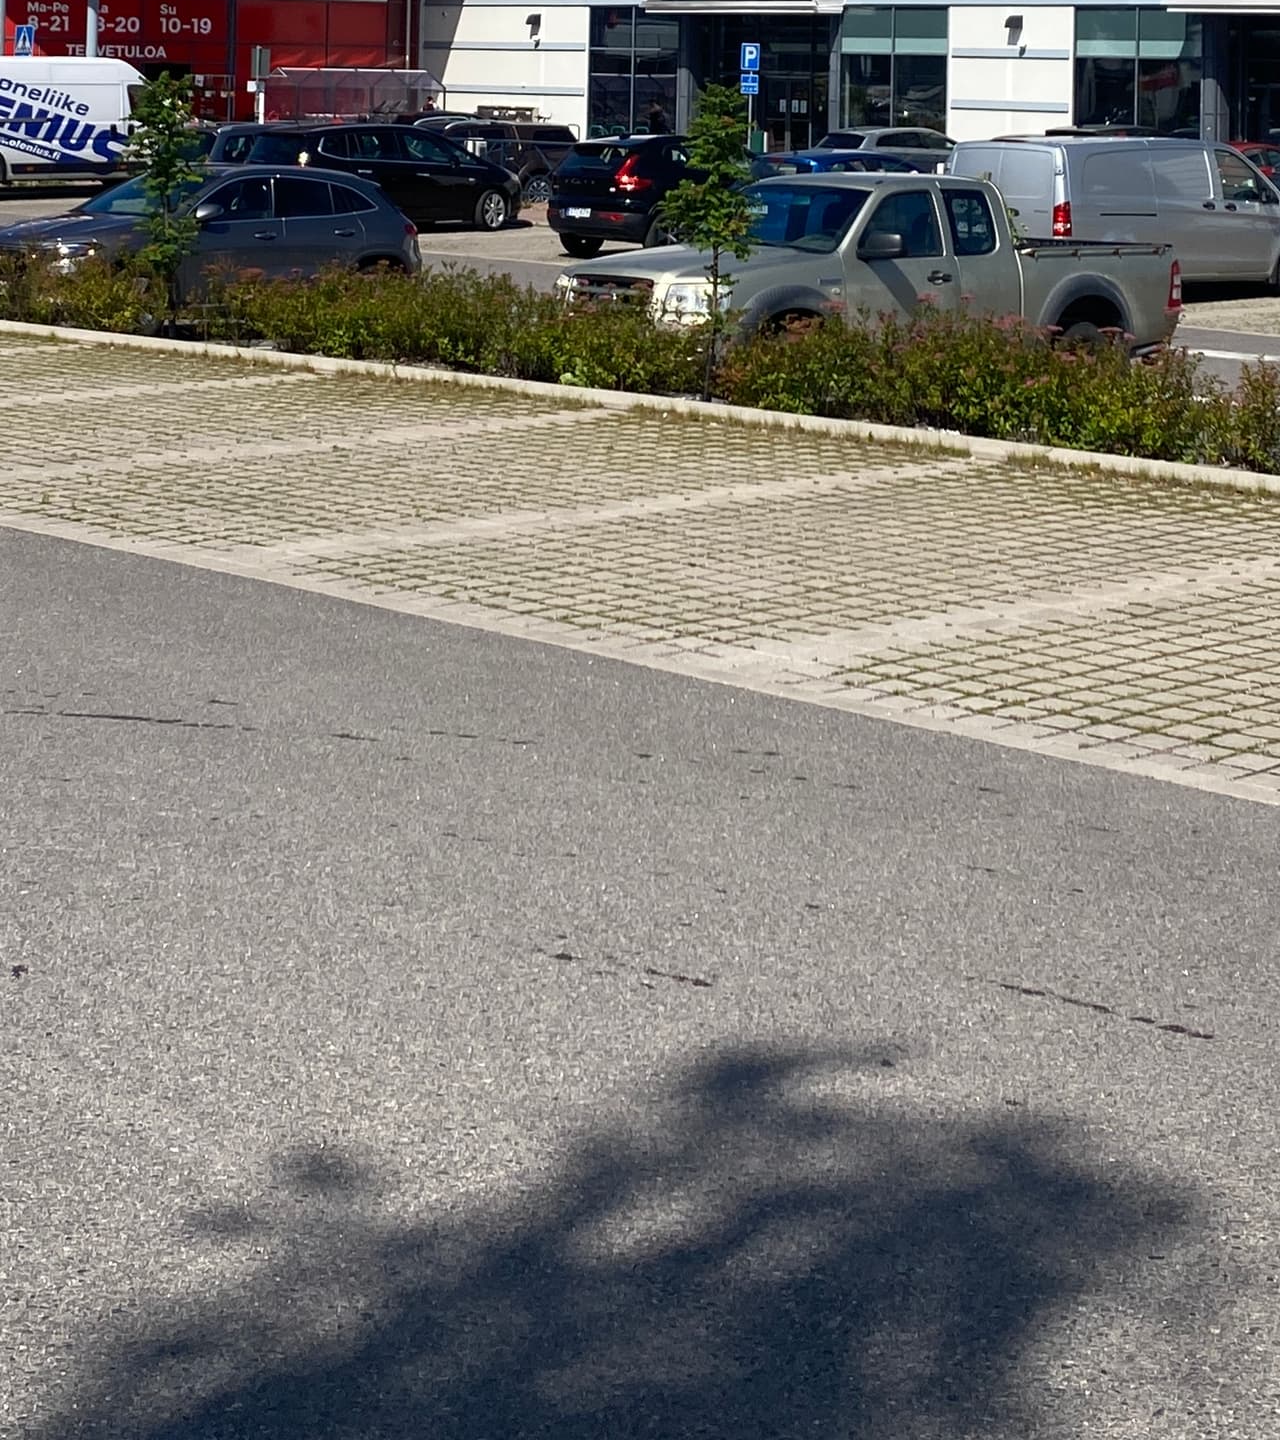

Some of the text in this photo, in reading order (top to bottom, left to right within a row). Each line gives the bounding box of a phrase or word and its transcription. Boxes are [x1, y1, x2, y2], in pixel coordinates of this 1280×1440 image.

[27, 2, 69, 13] Ma-Pe
[160, 4, 177, 15] Su
[160, 18, 212, 34] 10-19
[66, 44, 167, 58] TEVETULOA
[745, 46, 757, 67] P
